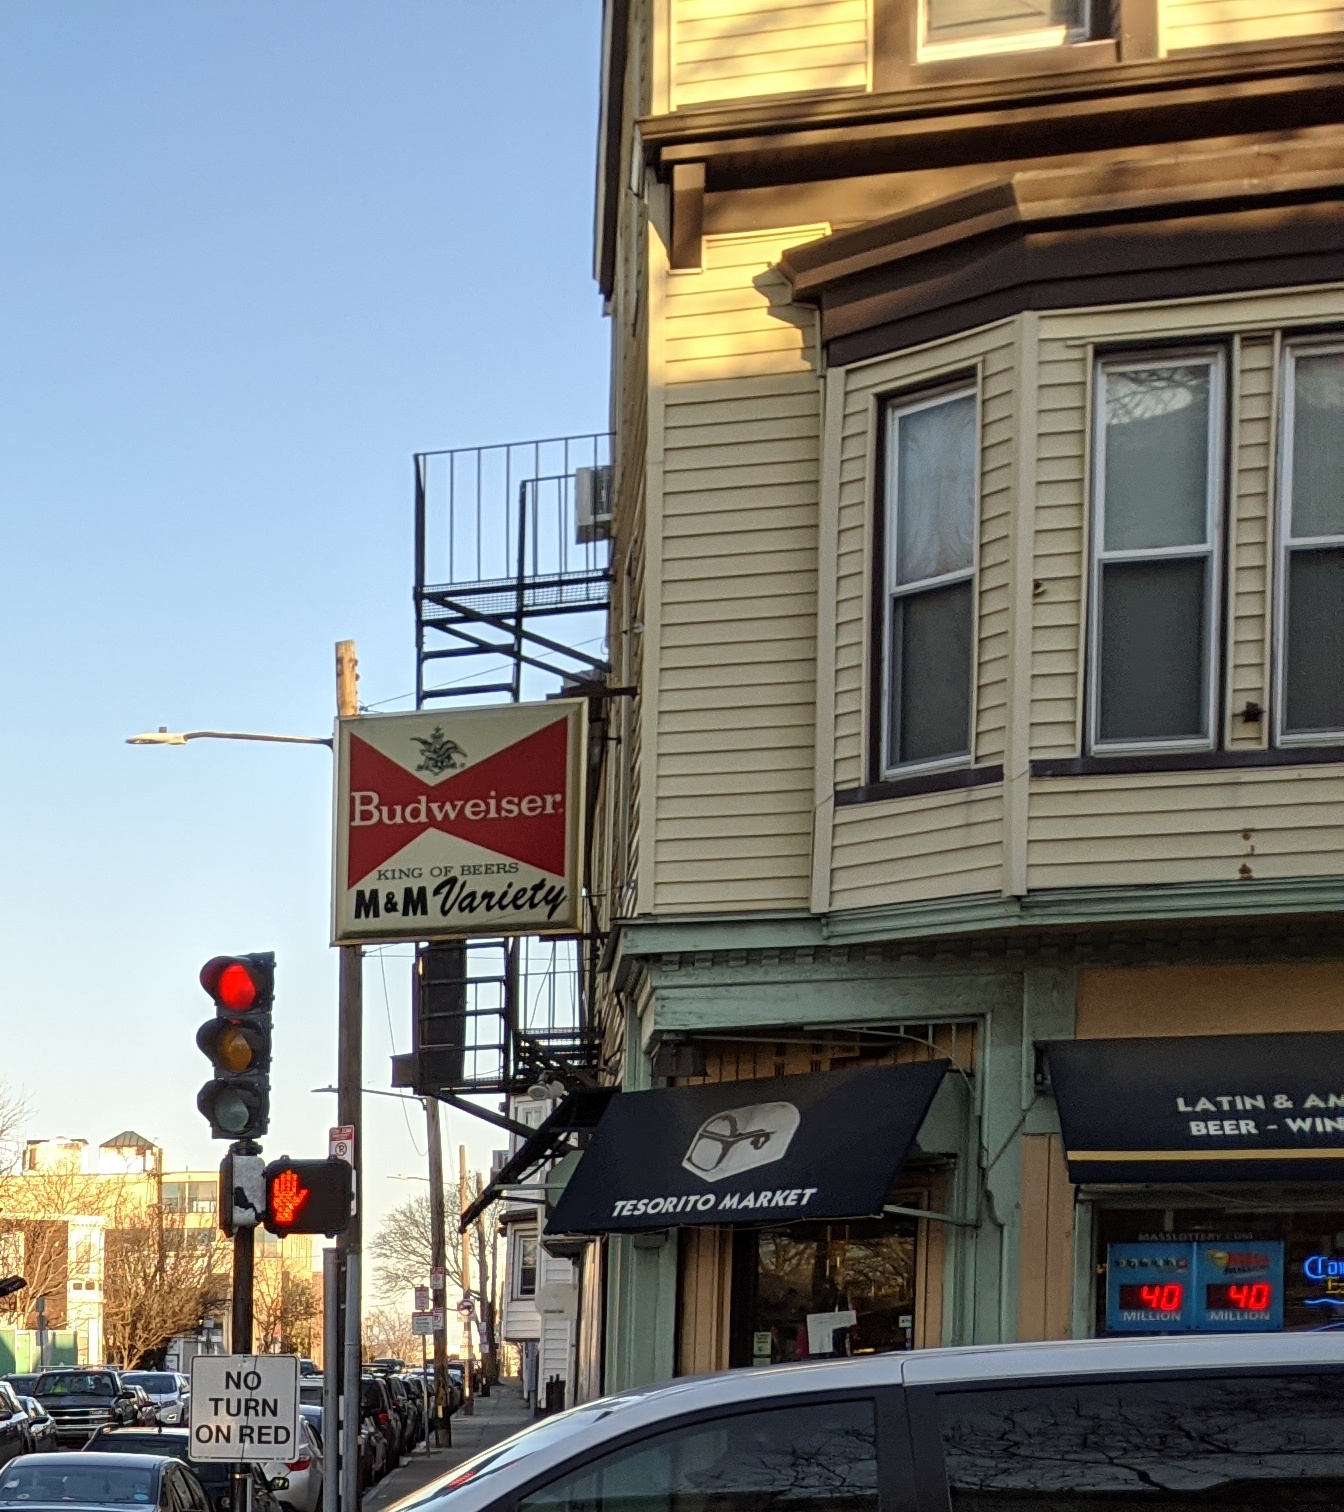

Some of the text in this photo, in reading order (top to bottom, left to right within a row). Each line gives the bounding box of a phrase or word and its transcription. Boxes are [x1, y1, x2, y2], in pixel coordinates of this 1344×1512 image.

[350, 790, 562, 826] Budweiser
[377, 862, 520, 881] KING OF BEERS
[354, 875, 568, 920] M&M Variety
[1176, 1094, 1266, 1112] LATIN
[1273, 1094, 1294, 1109] &
[1189, 1119, 1260, 1136] BEER
[1285, 1117, 1344, 1134] WIN
[612, 1187, 818, 1218] TESORITO MARKET
[1141, 1283, 1184, 1311] 40
[1228, 1283, 1272, 1311] 40
[1123, 1311, 1182, 1321] MILLION
[1211, 1310, 1271, 1320] MILLION
[225, 1370, 262, 1391] NO
[208, 1397, 278, 1418] TURN
[195, 1424, 291, 1445] ON RED
